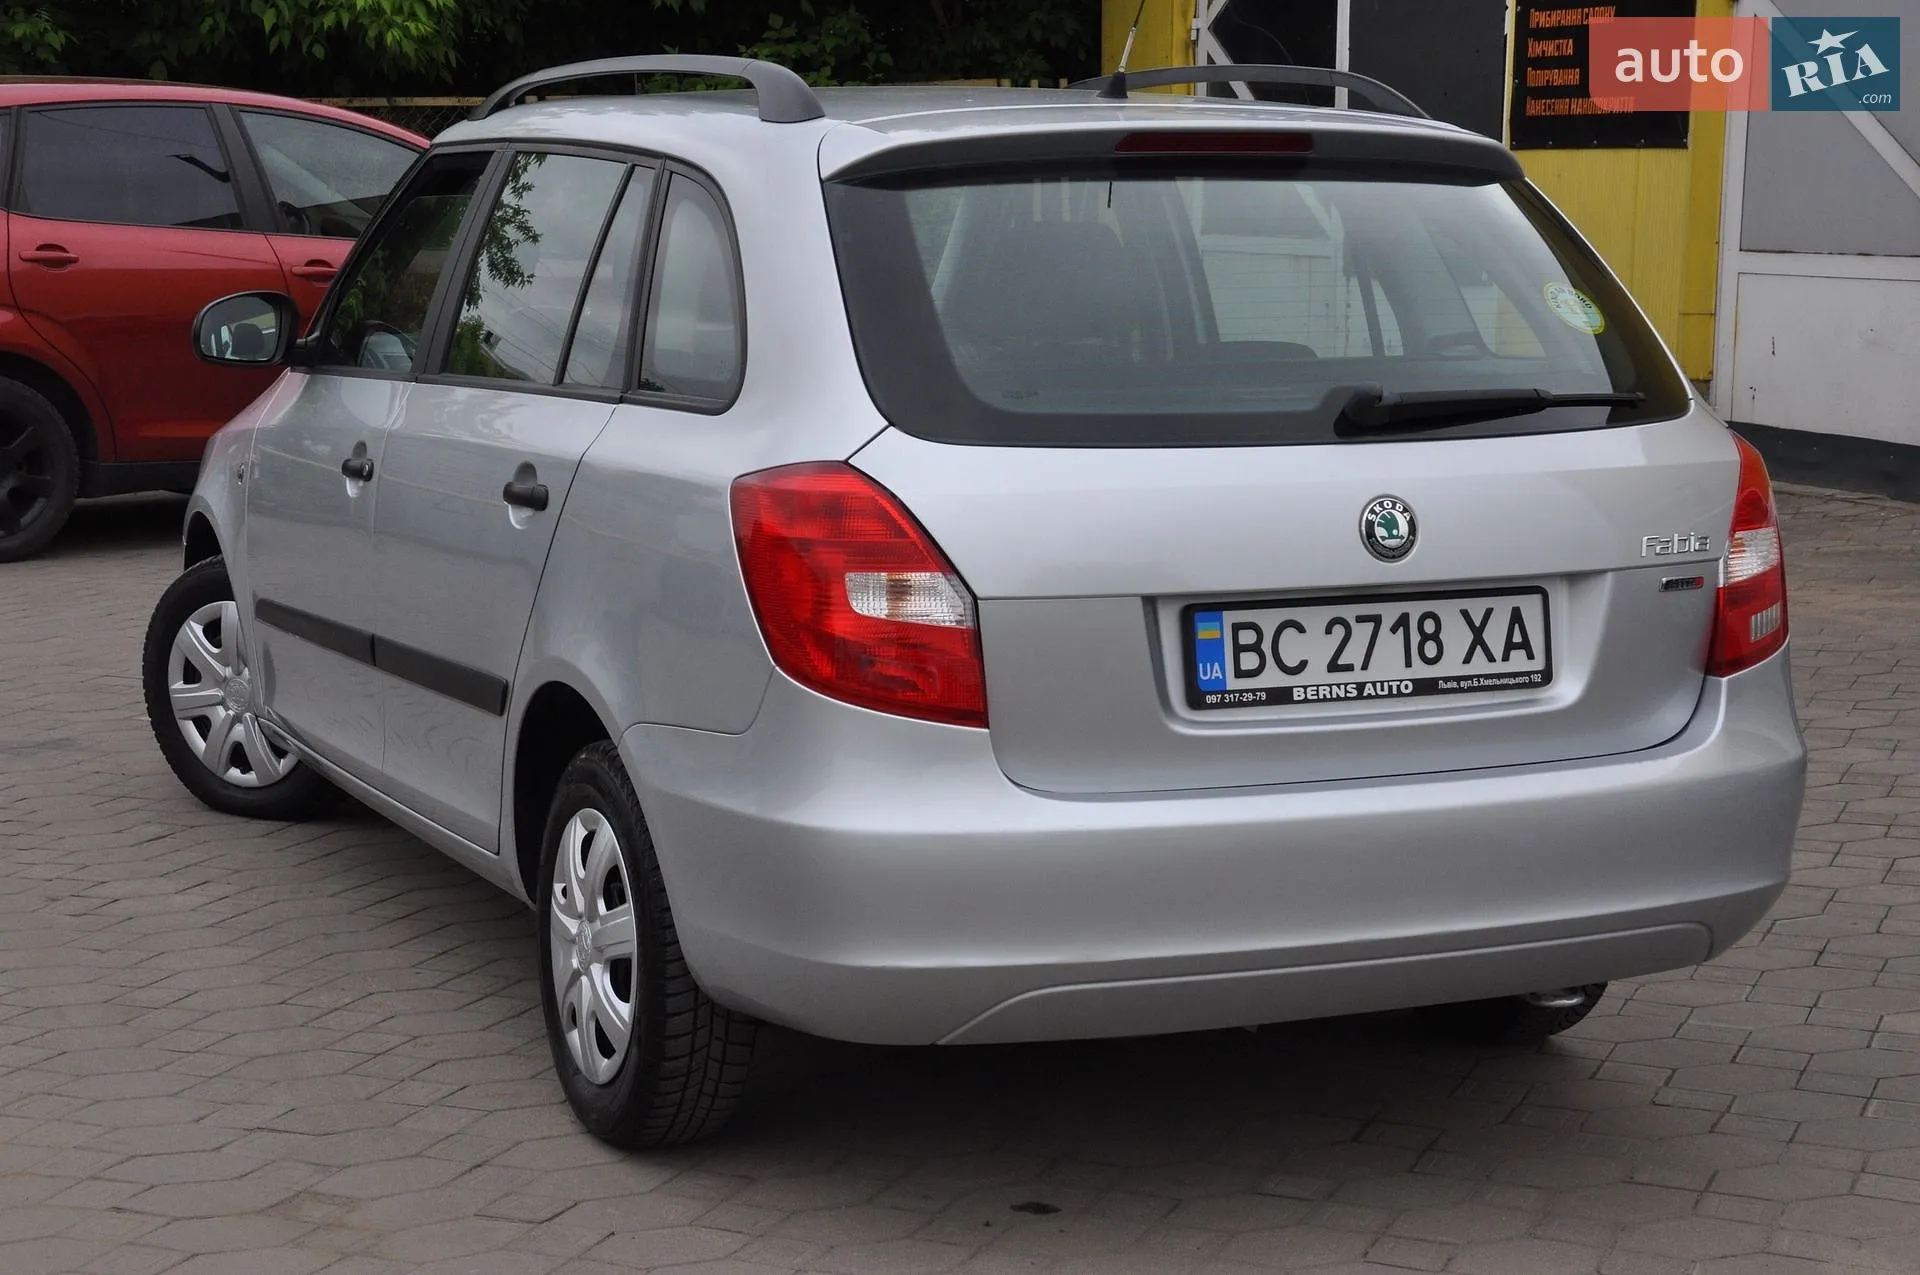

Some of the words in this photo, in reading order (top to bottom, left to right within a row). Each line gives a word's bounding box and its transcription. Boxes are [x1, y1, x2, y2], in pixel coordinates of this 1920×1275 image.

[1641, 531, 1710, 557] Fabia
[1231, 618, 1309, 679] BC
[1325, 610, 1444, 673] 2718
[1459, 606, 1536, 665] XA
[1199, 661, 1223, 680] UA
[1530, 673, 1542, 683] 192
[1206, 694, 1221, 704] 097
[1224, 691, 1267, 702] 317-29-79
[1292, 683, 1358, 701] BERNS
[1363, 680, 1414, 697] AUTO
